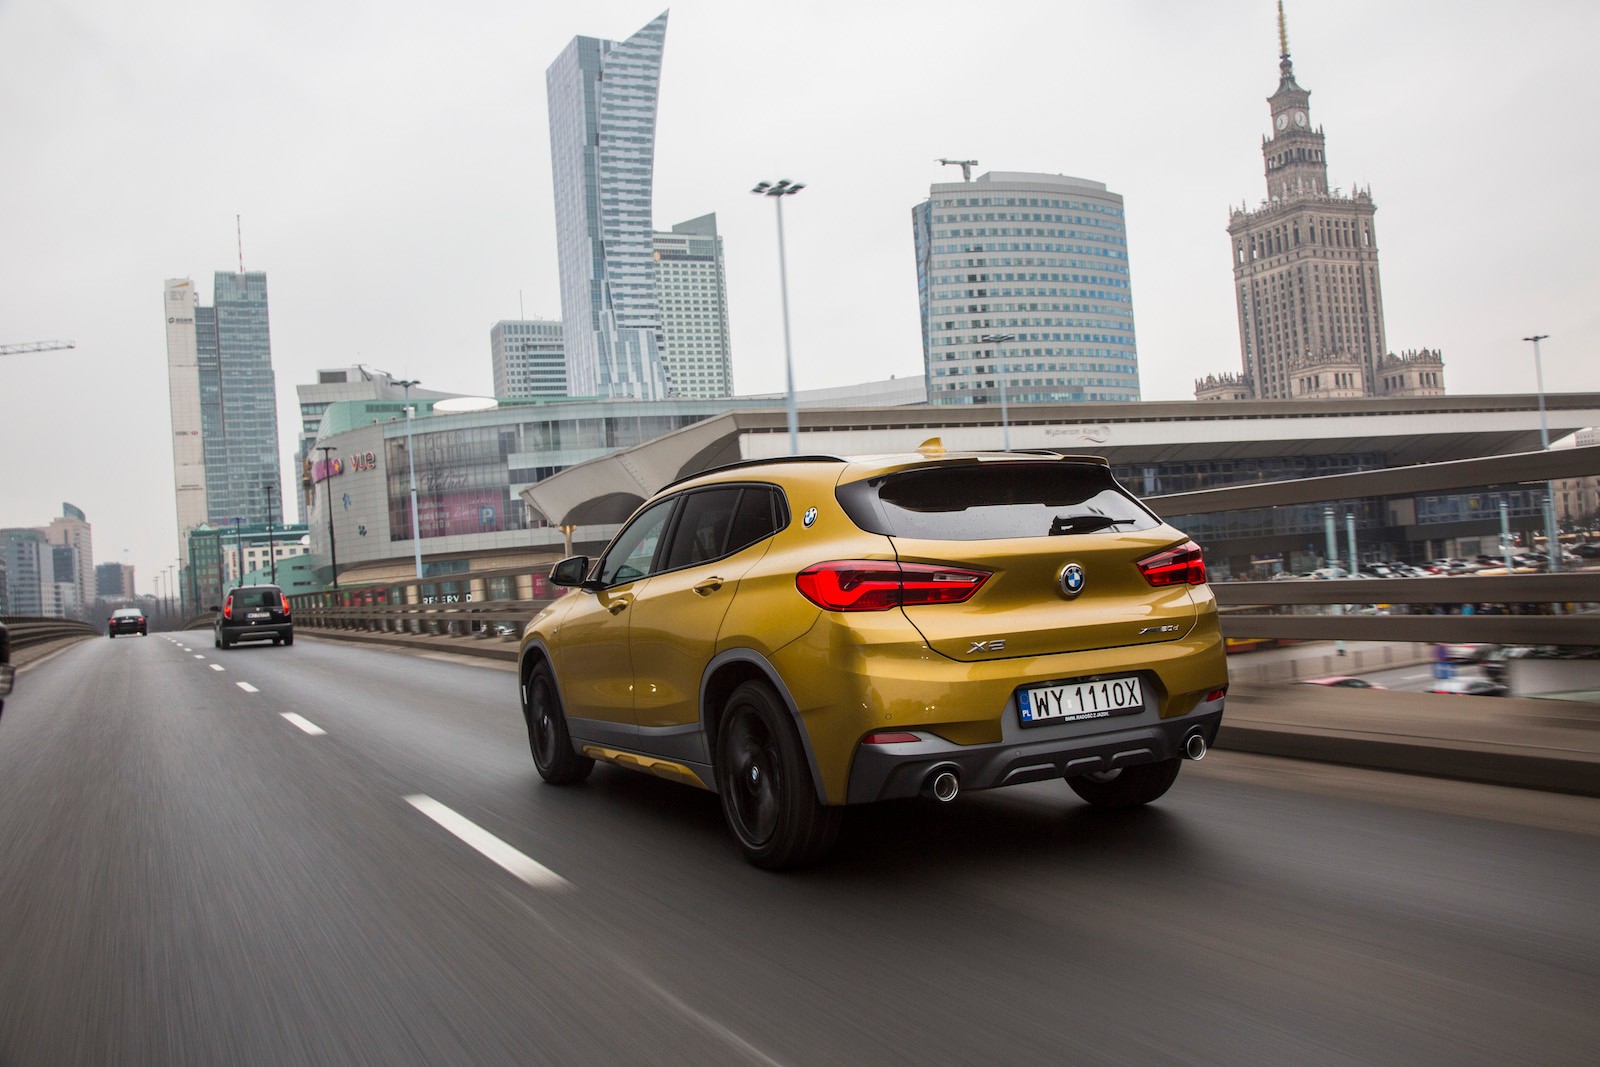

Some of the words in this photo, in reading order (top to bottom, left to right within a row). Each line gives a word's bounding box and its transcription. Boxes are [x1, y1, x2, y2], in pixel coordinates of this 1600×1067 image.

[966, 639, 1006, 654] X2
[1034, 689, 1064, 717] WY
[1075, 680, 1139, 711] 1110X
[1022, 709, 1031, 717] PL
